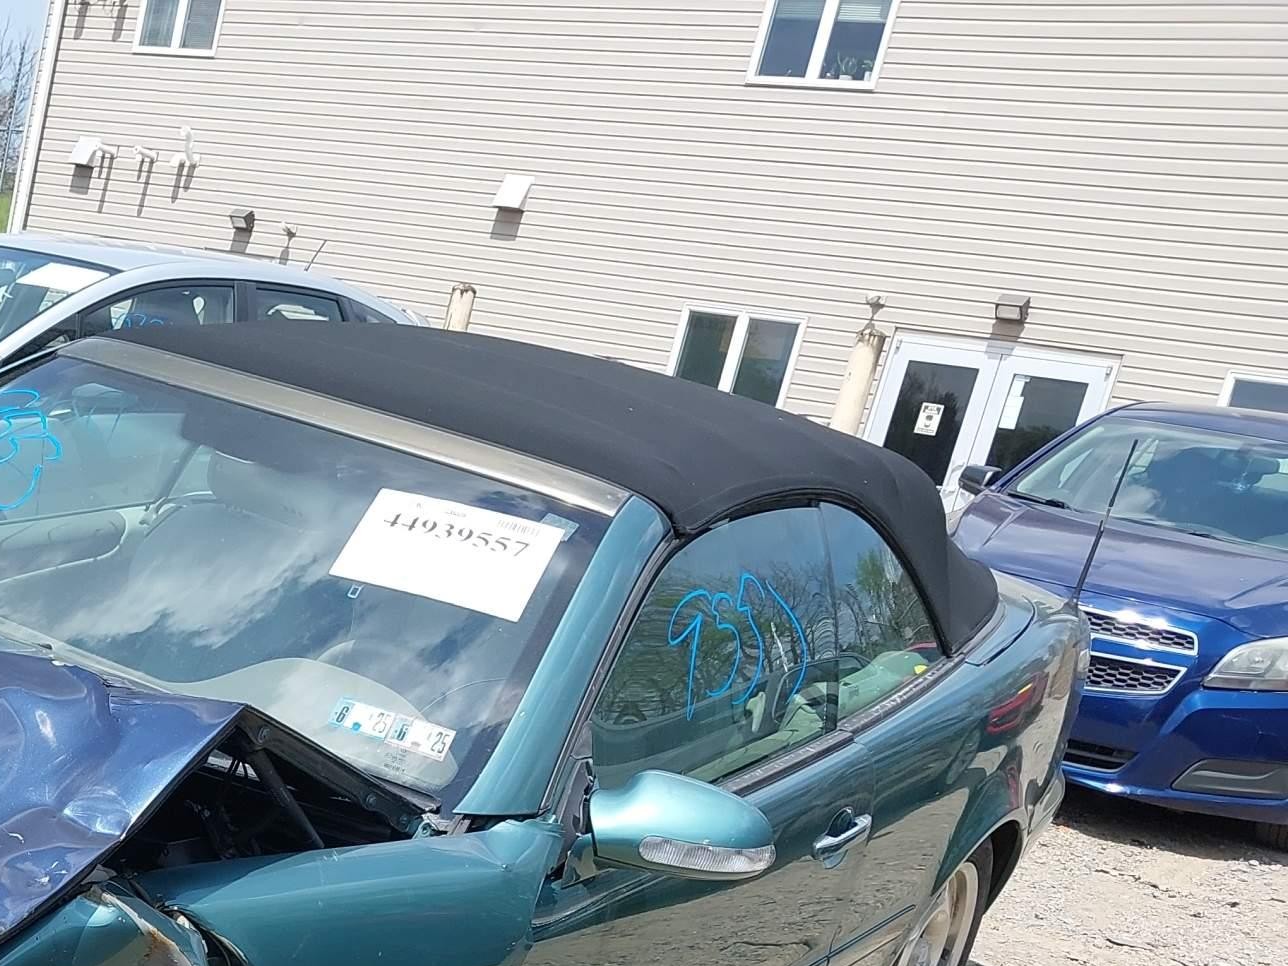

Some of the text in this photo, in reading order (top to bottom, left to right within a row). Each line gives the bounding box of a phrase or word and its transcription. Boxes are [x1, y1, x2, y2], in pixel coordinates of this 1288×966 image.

[383, 512, 530, 557] 44939557
[335, 705, 350, 724] 6
[430, 730, 451, 754] 25
